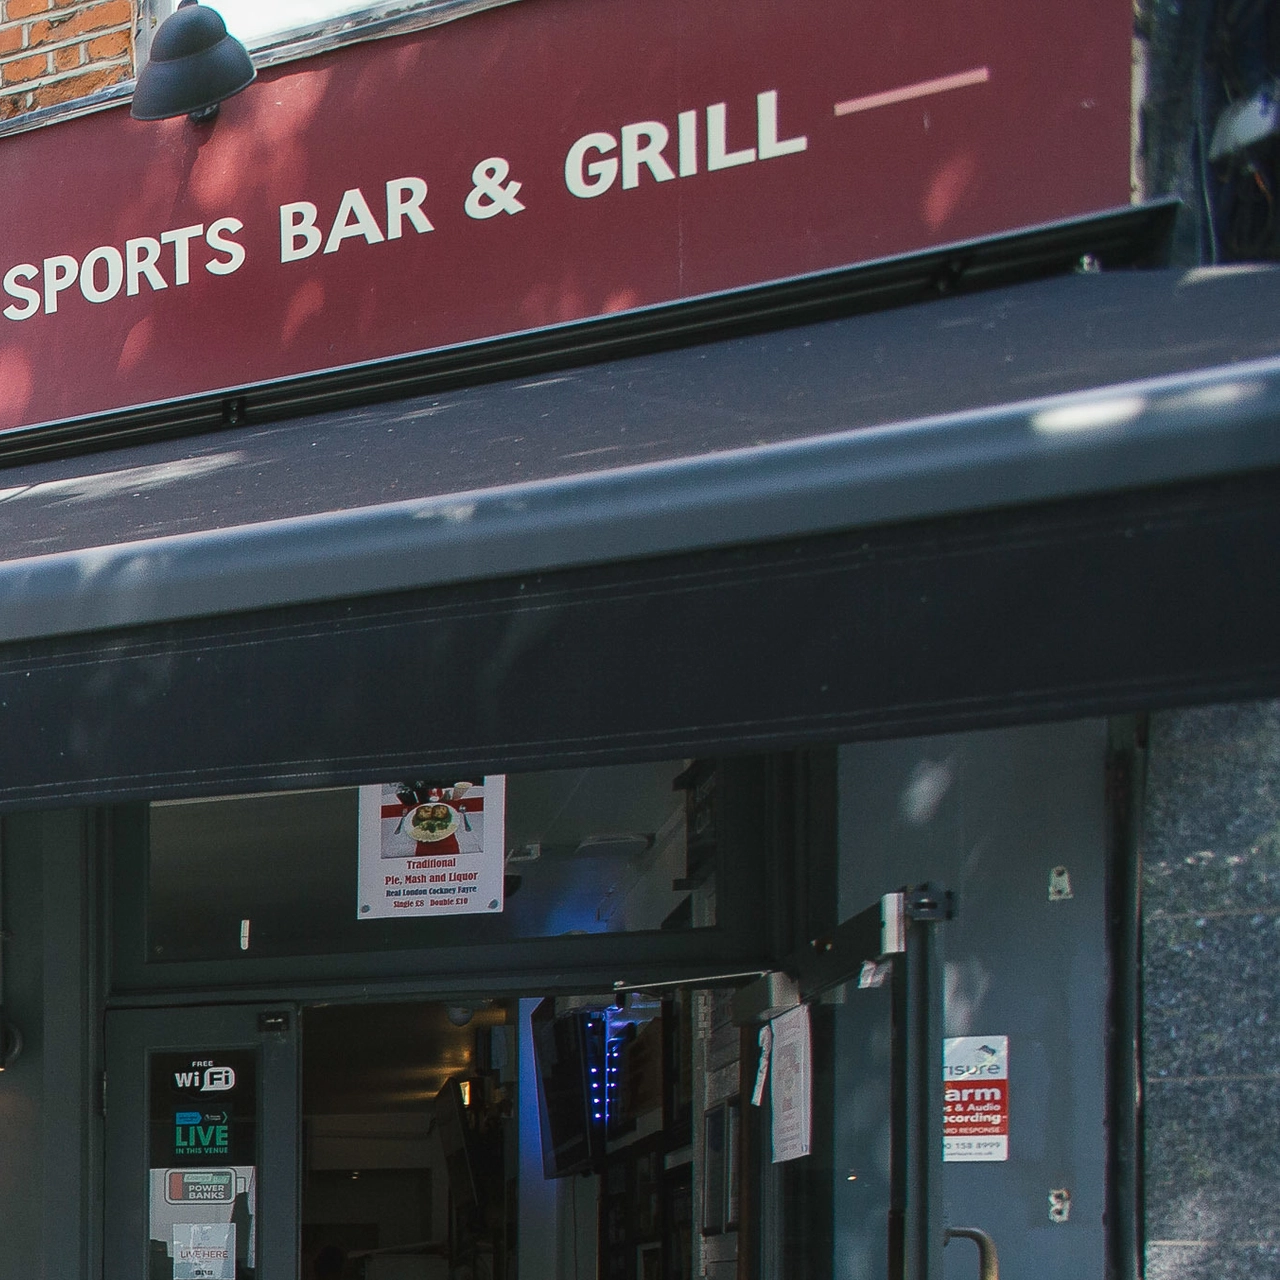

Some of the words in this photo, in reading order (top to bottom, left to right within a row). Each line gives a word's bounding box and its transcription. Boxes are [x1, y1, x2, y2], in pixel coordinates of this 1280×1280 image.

[2, 217, 246, 321] SPORTS
[279, 177, 435, 263] BAR
[464, 157, 526, 219] &
[565, 90, 808, 198] GRILL
[406, 858, 456, 869] Traditional
[405, 874, 427, 884] Mash
[429, 873, 446, 883] and
[449, 871, 479, 883] Liquor
[386, 889, 401, 897] Real
[403, 888, 428, 896] London
[429, 887, 457, 896] Cockney
[458, 885, 477, 894] Fayre
[430, 898, 454, 906] Double
[967, 1102, 1001, 1112] Audio
[175, 1125, 229, 1146] LIVE
[188, 1184, 225, 1192] POWER
[188, 1192, 225, 1200] BANKS
[202, 1250, 229, 1258] HERE
